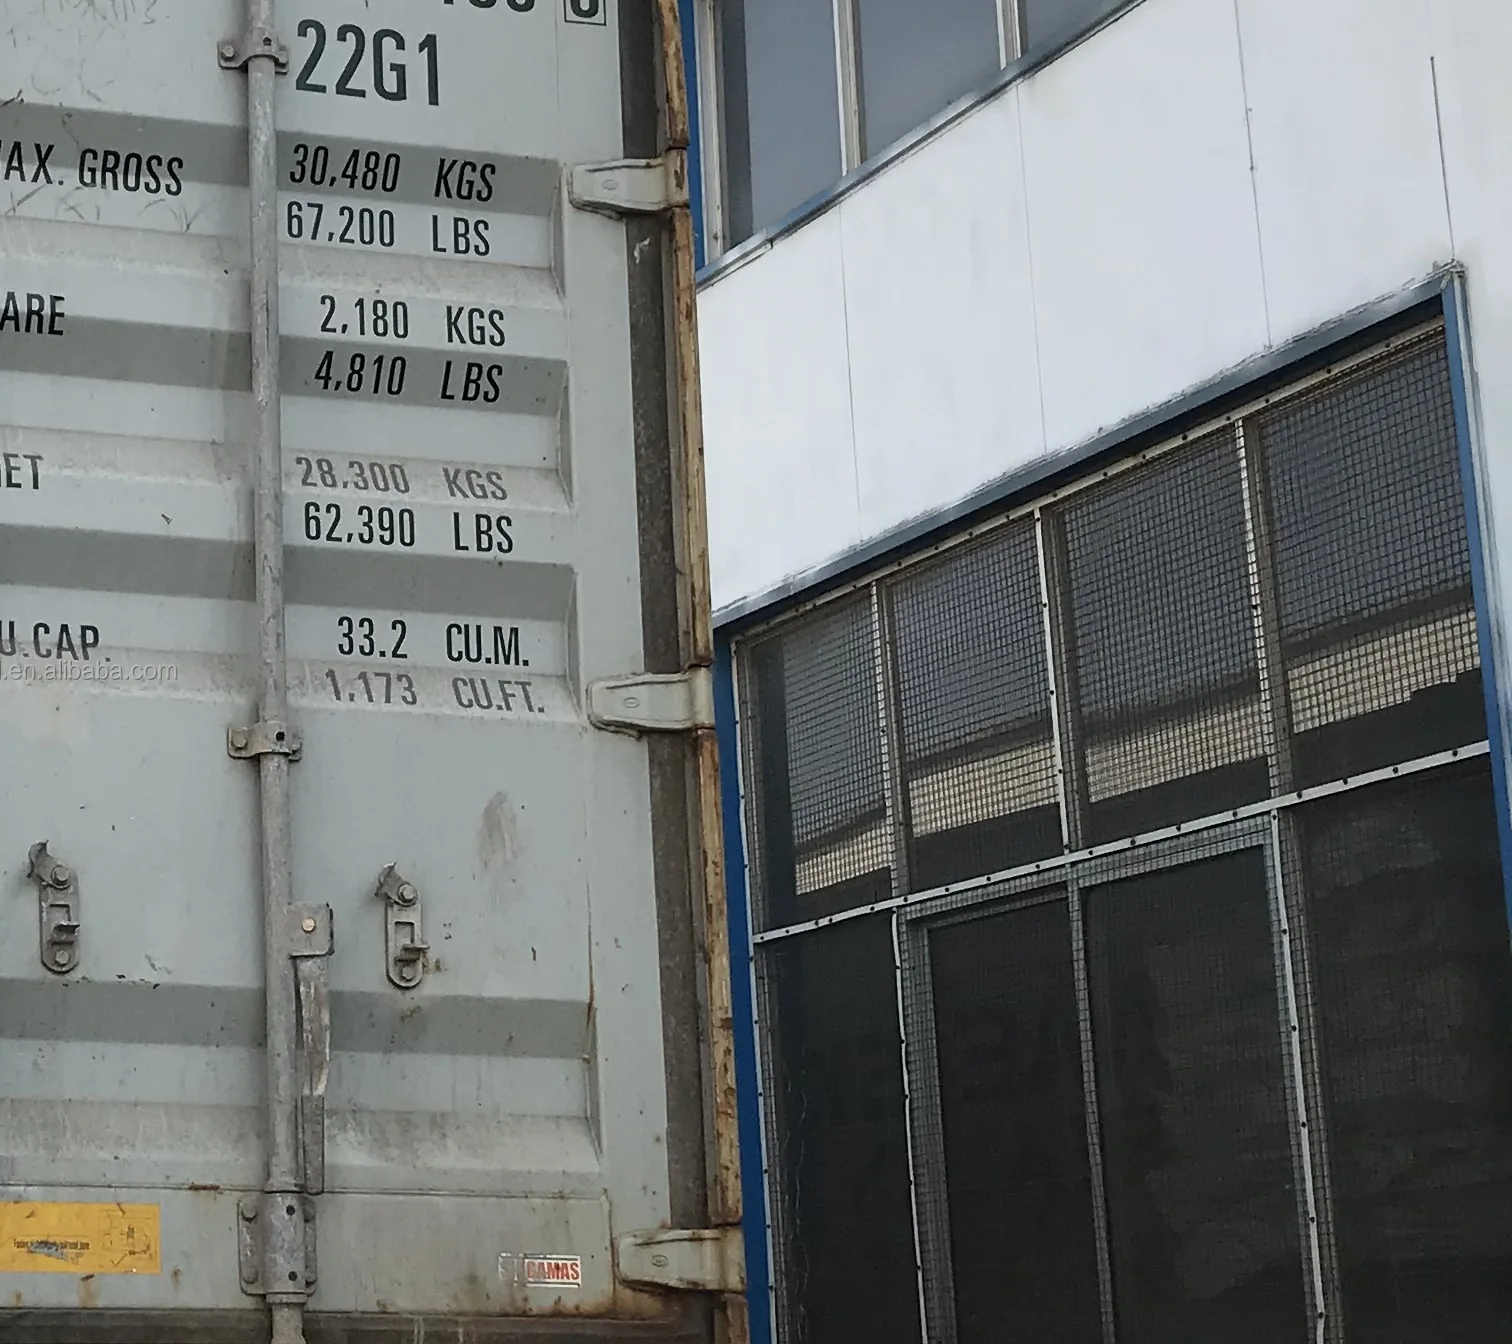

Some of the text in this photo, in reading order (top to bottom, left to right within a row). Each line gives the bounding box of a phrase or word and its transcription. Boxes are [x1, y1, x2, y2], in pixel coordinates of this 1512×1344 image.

[294, 18, 440, 106] 22G1
[78, 148, 183, 196] GROSS
[289, 144, 401, 193] 30,480
[434, 157, 497, 202] KGS
[287, 200, 490, 256] 67,200 LBS
[320, 295, 409, 338] 2,180
[446, 305, 506, 347] KGS
[314, 350, 504, 403] 4,810 LBS
[442, 467, 508, 501] KGS
[304, 501, 514, 554] 62,390 LBS
[338, 616, 408, 659] 33.2
[446, 623, 530, 667] CU.M.
[451, 676, 545, 714] CU.FT.
